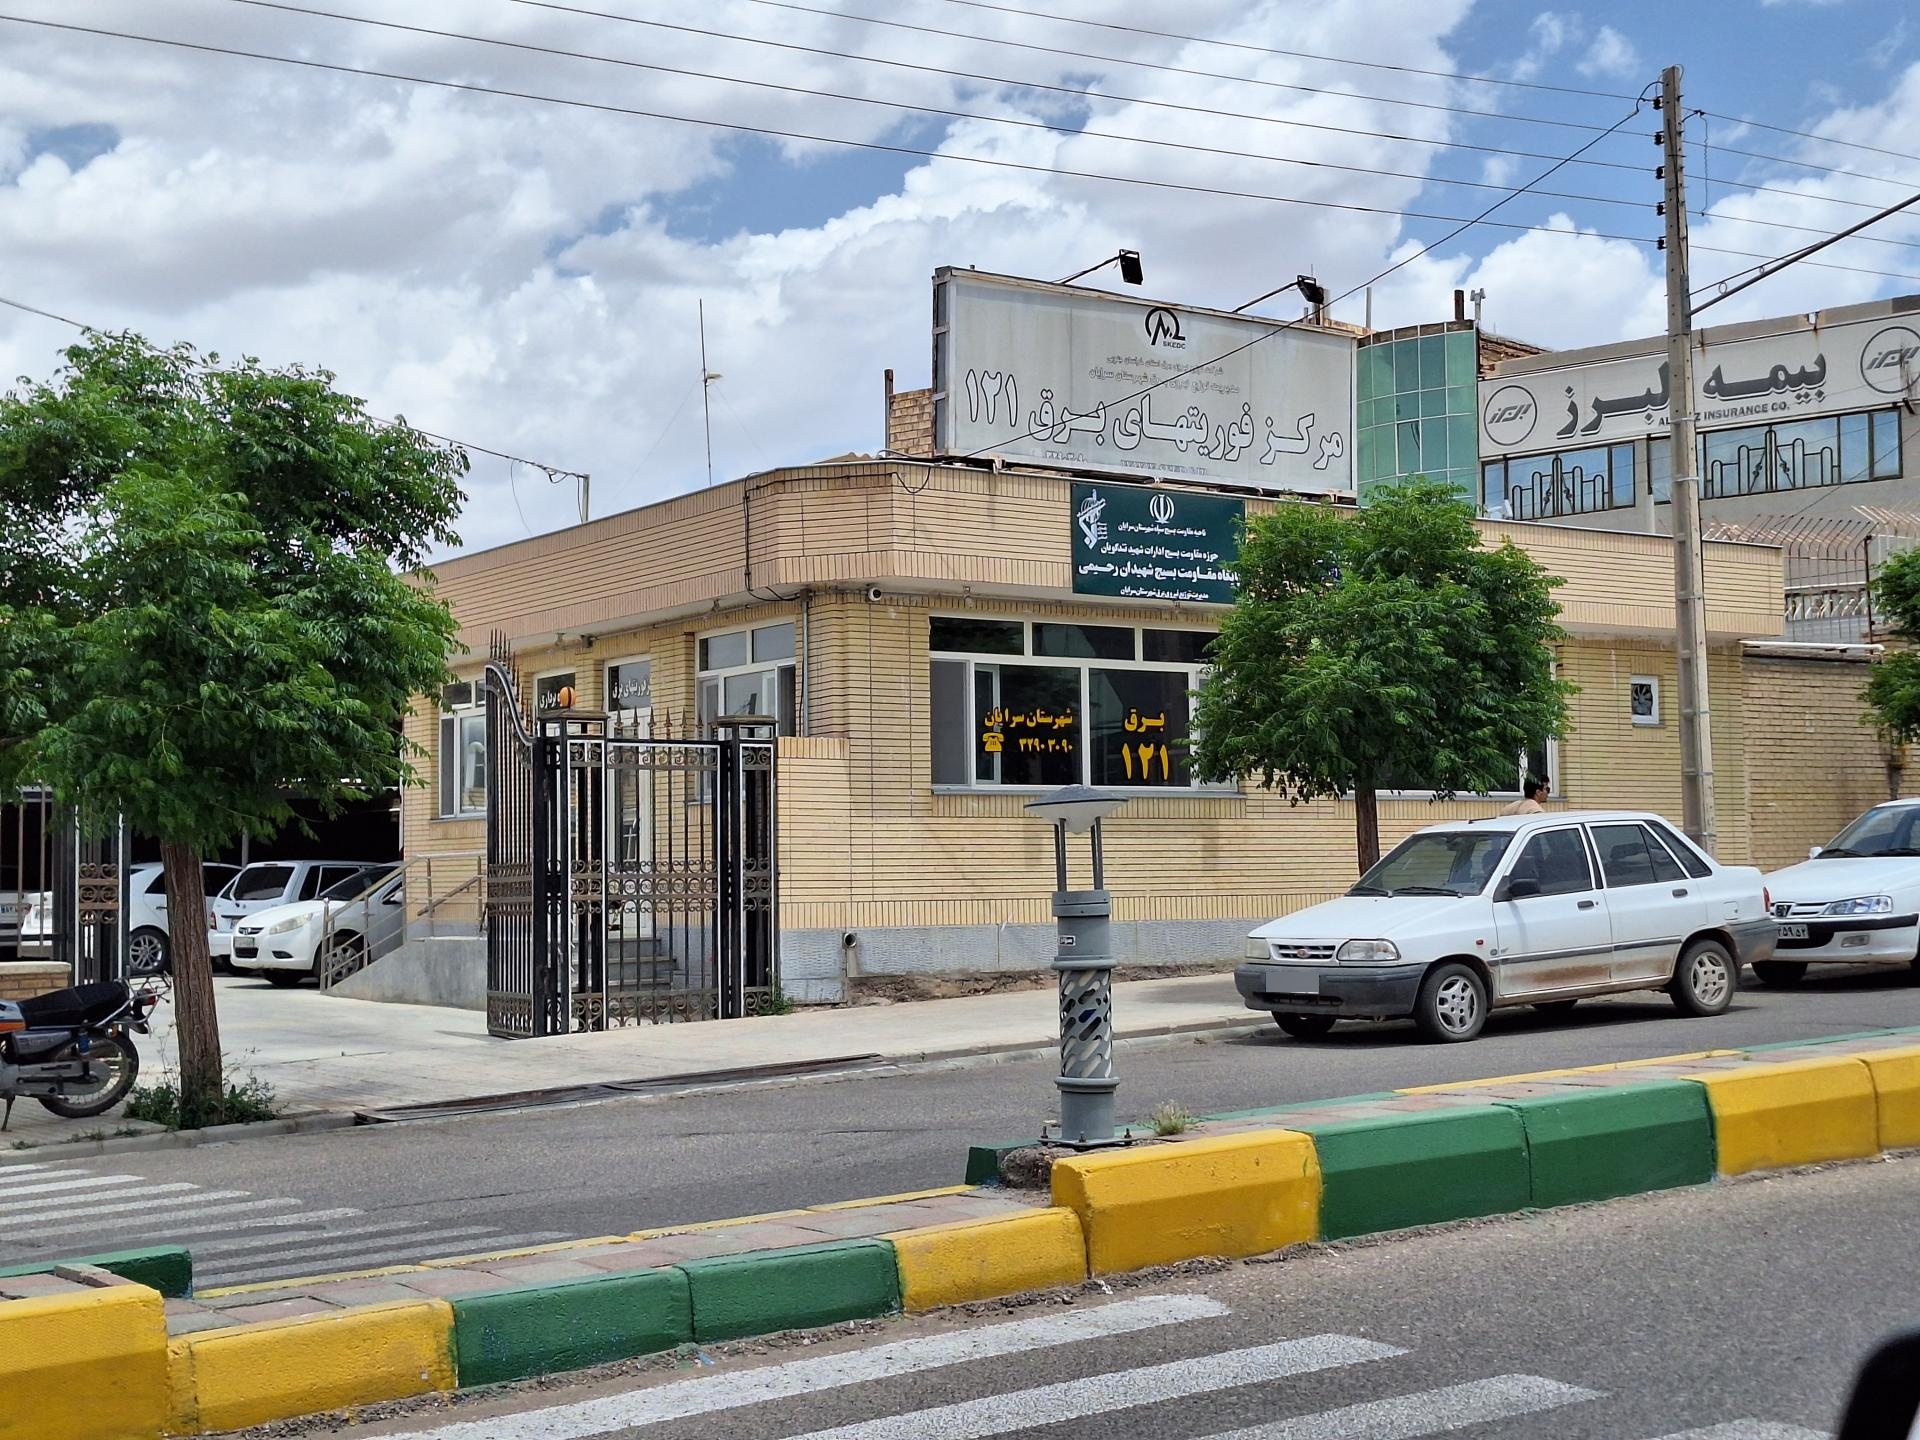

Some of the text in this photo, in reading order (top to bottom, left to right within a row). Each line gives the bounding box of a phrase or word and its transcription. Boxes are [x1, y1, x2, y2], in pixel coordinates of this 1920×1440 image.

[1557, 352, 1827, 439] بیمه لبرز
[964, 368, 1345, 470] مرکز فوریتهای برق ۱۲۱
[1658, 401, 1790, 426] ALZ INSURANCE CO.
[1100, 541, 1219, 562] حوزه مقاومت بسیج ادارات شهید تندگویان
[1078, 561, 1119, 577] رحیمی
[1119, 560, 1154, 578] شهیدان
[1154, 567, 1177, 581] بسیج
[1177, 566, 1218, 583] مقاومت
[984, 706, 1073, 729] شهرستان سرایان
[1124, 708, 1165, 733] برق
[1121, 742, 1169, 781] ۱۲۱
